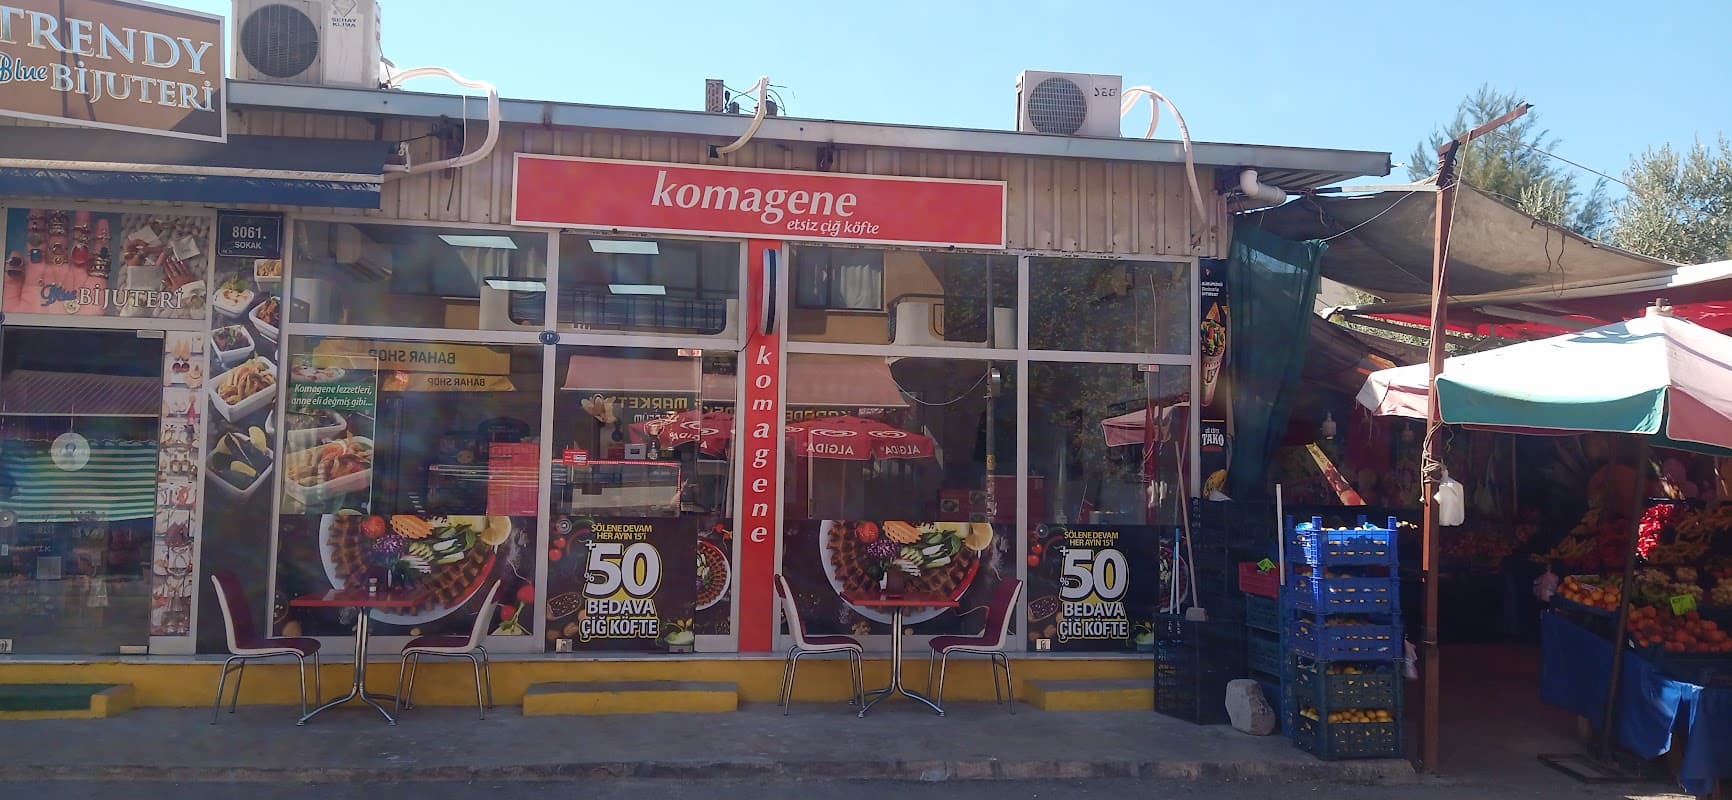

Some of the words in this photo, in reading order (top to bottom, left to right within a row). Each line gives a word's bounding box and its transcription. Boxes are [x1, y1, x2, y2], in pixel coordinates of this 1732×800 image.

[0, 4, 214, 75] TRENDY
[0, 51, 49, 85] Blue
[49, 60, 216, 113] BİJUTERİ
[651, 169, 858, 224] komagene
[232, 226, 267, 240] 8061.
[786, 218, 818, 233] etsiz
[820, 219, 842, 238] çiğ
[843, 220, 880, 236] köfte
[234, 241, 262, 249] SOKAK
[78, 284, 185, 310] BİJUTERİ
[294, 384, 336, 396] Komagene
[336, 384, 372, 395] lezzetleri,
[311, 396, 322, 405] eli
[750, 345, 774, 542] komagene
[597, 532, 614, 540] HER
[614, 532, 633, 540] AYIN
[623, 525, 652, 533] DEVAM
[1093, 532, 1119, 540] DEVAM
[1069, 539, 1085, 547] HER
[1085, 539, 1102, 547] AYIN
[587, 600, 655, 615] BEDAVA
[1064, 602, 1125, 617] BEDAVA
[581, 616, 607, 638] ÇİĞ
[610, 615, 658, 635] KÖFTE
[1059, 617, 1084, 640] ÇİĞ
[1085, 616, 1129, 636] KÖFTE
